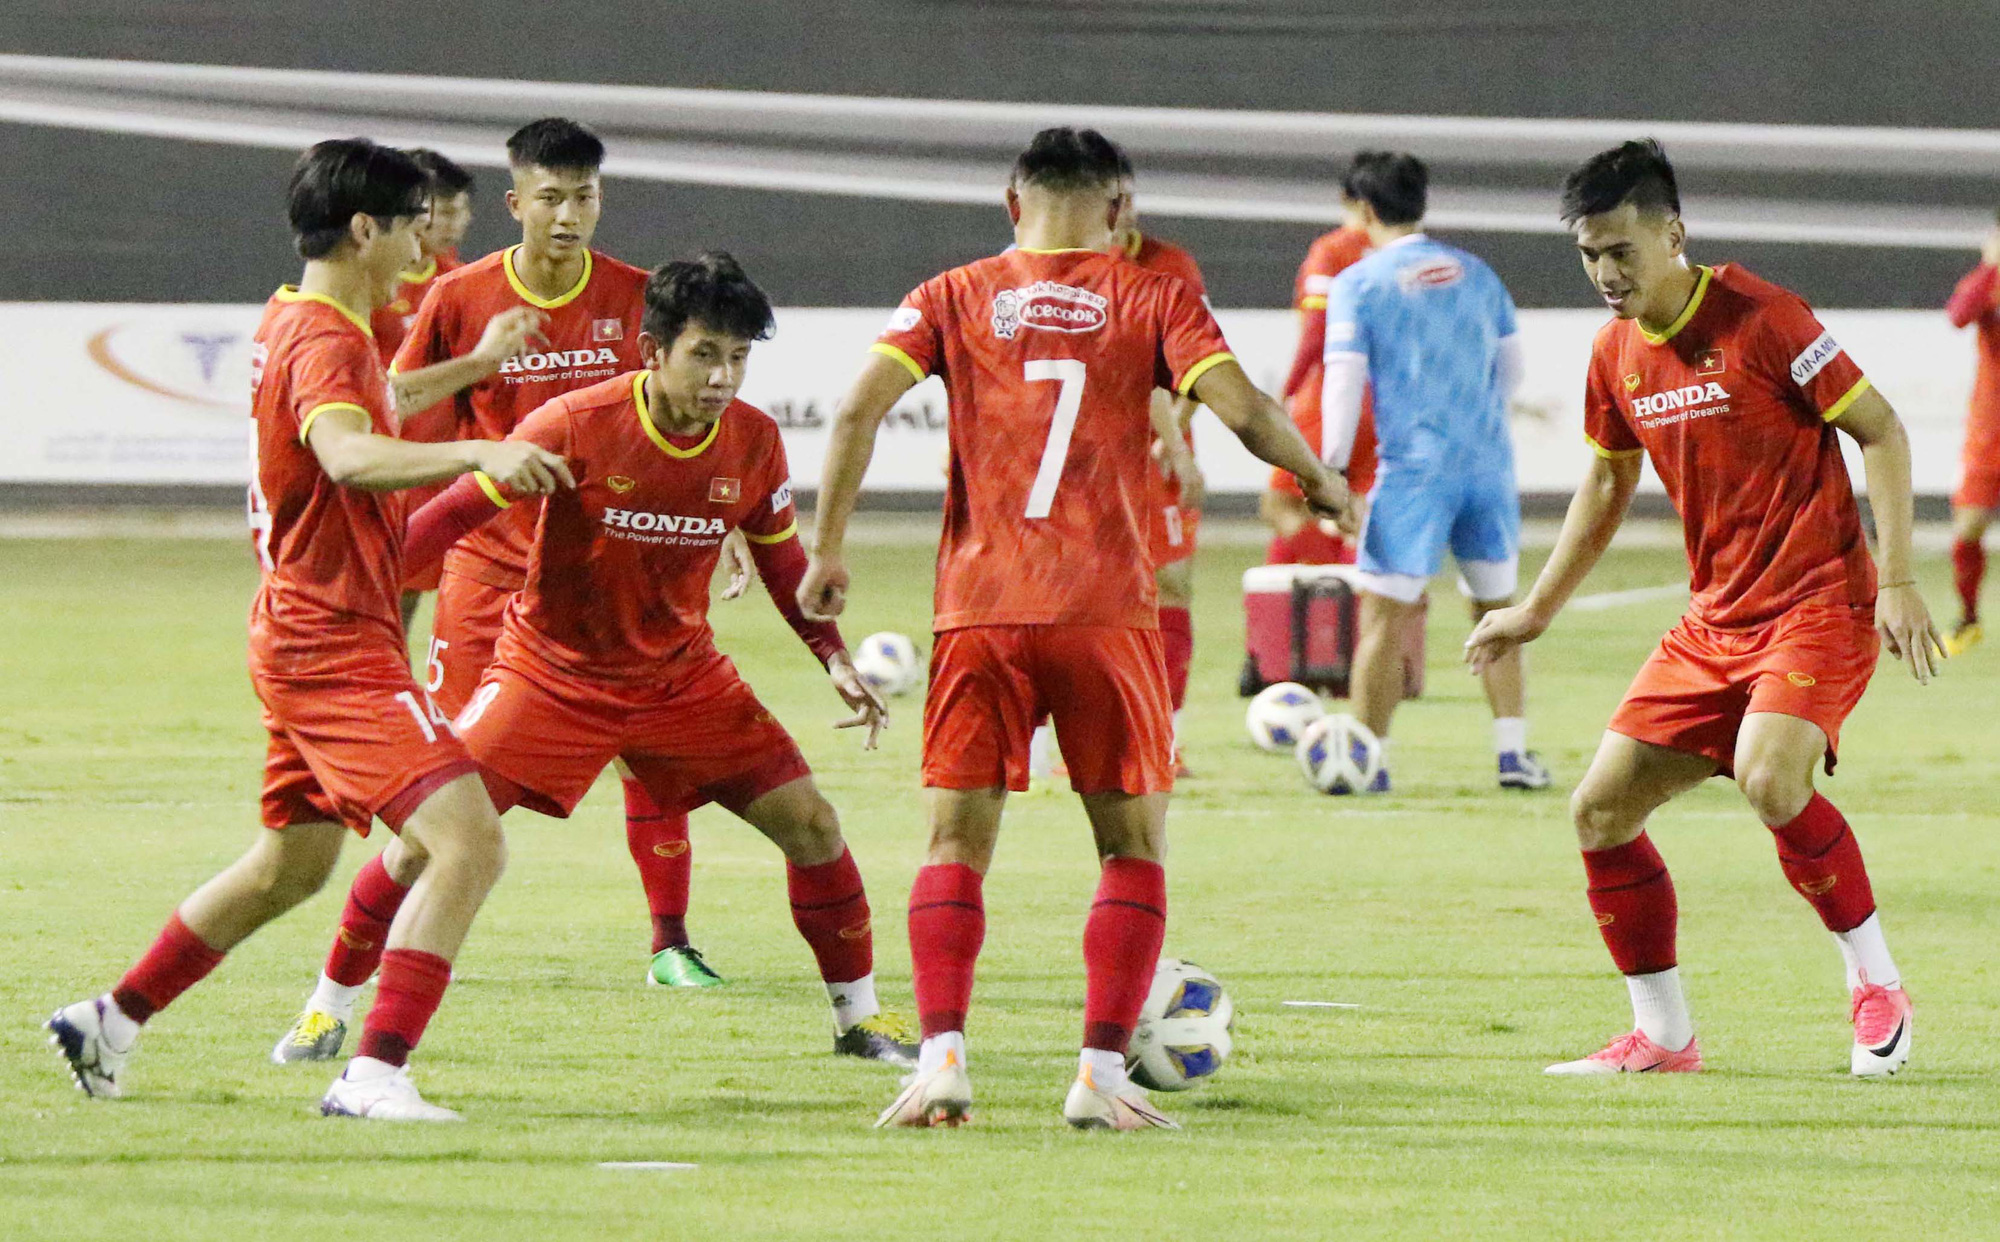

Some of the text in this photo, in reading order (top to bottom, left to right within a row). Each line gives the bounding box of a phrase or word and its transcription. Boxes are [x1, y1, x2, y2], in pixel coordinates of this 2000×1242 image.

[498, 348, 619, 373] HONDA
[503, 367, 616, 385] The Power of Dreams
[1632, 381, 1731, 418] HONDA
[1640, 404, 1730, 430] The Power of Dreams
[1024, 358, 1087, 519] 7
[601, 507, 727, 535] HONDA
[604, 527, 719, 547] The Power of Dreams
